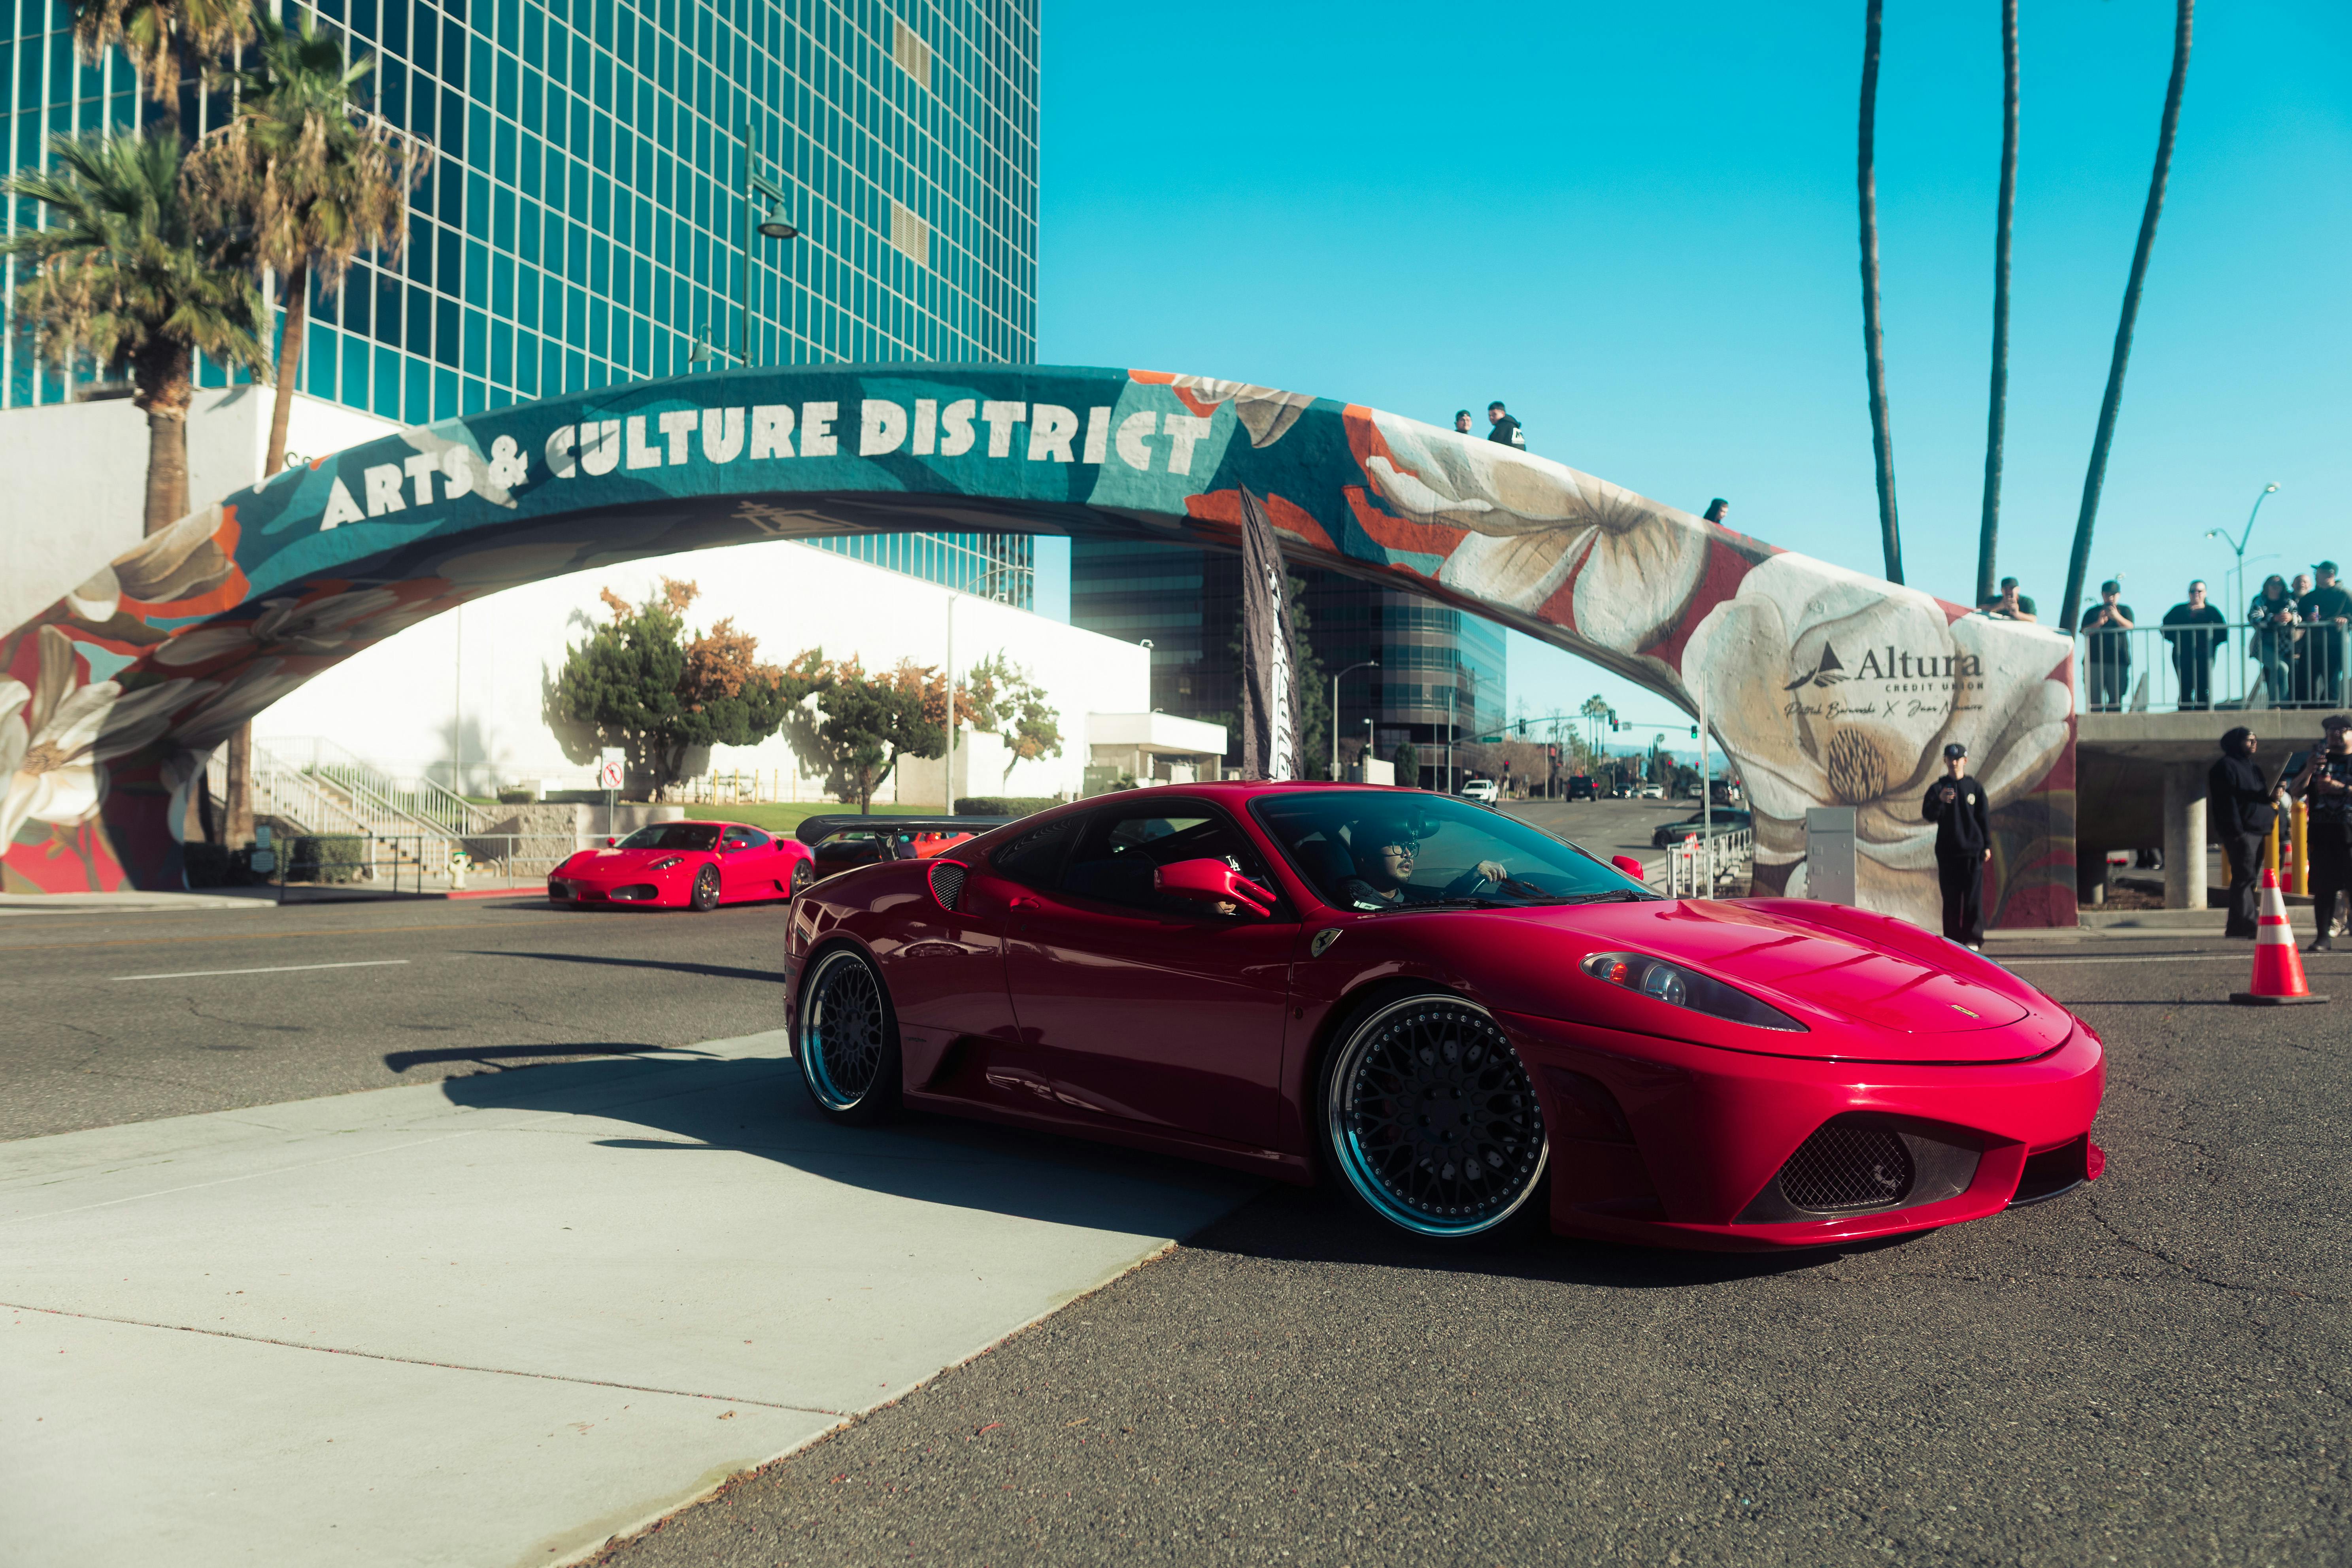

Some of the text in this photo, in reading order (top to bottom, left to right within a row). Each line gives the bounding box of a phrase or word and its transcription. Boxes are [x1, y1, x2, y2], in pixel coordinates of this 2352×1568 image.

[319, 398, 1212, 531] ARTS & CULTURE DISTRICT
[1854, 645, 1984, 680] Altura
[1886, 682, 1984, 692] CREDIT UNION
[1226, 855, 1240, 871] LA
